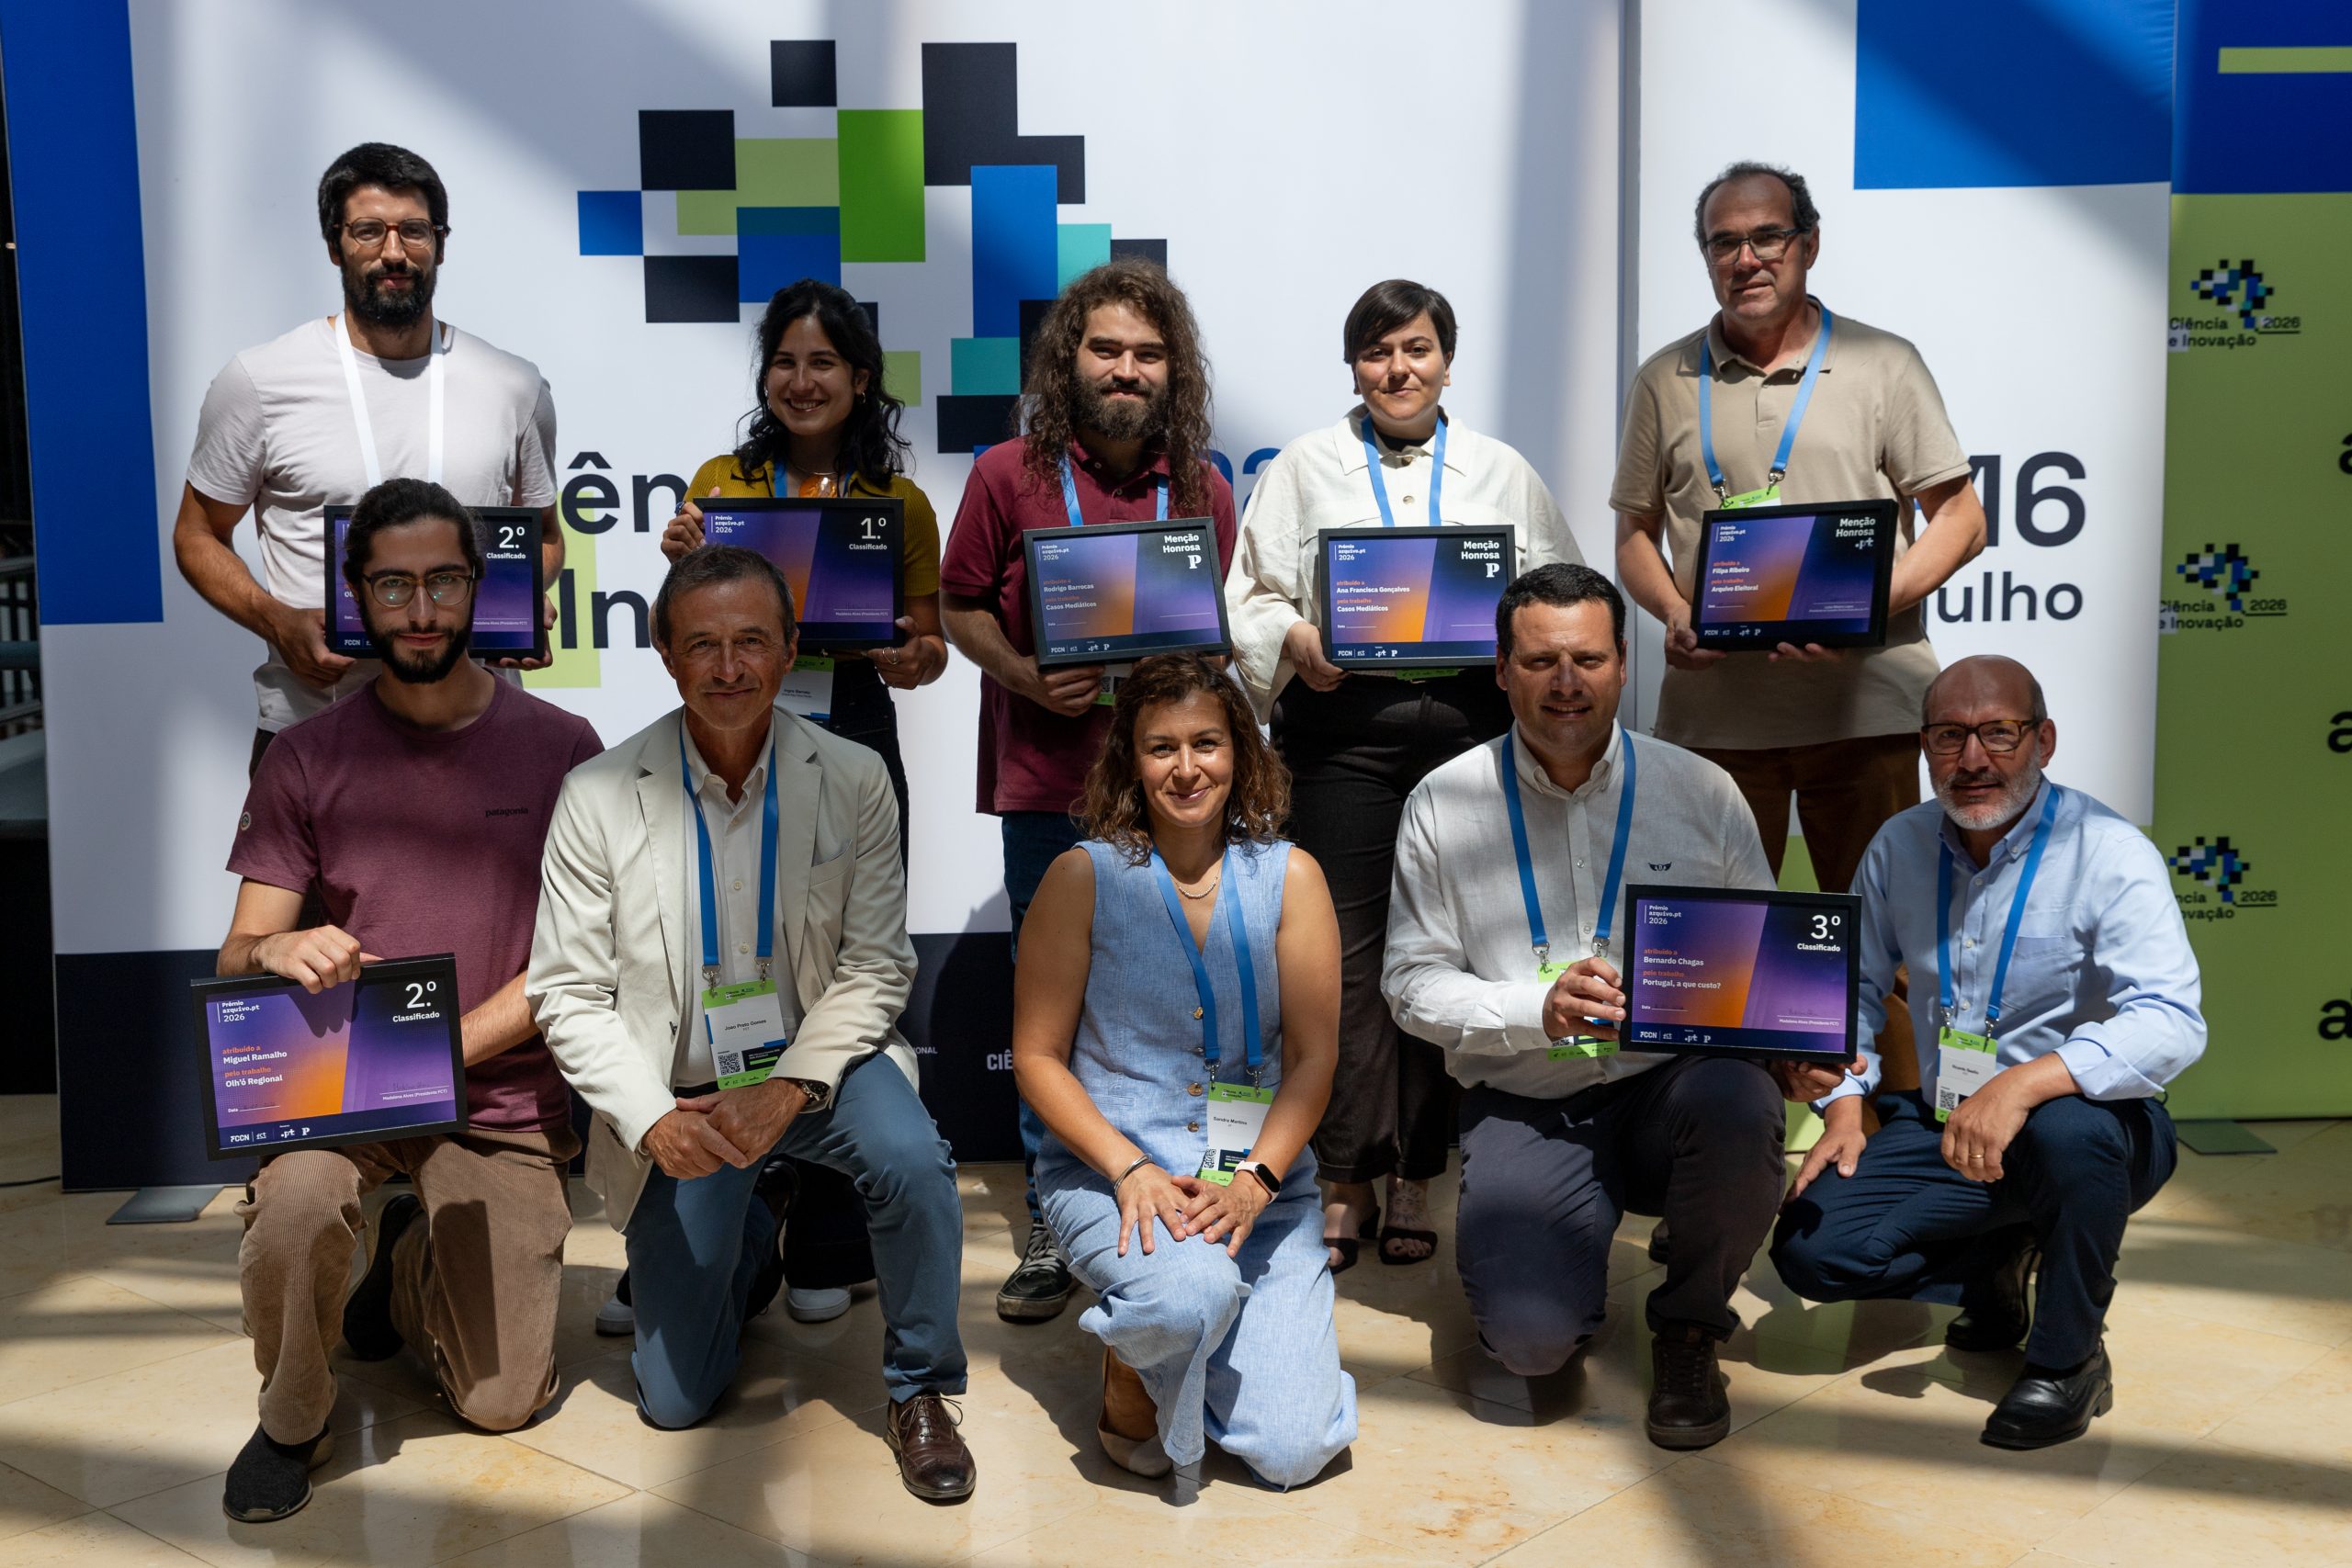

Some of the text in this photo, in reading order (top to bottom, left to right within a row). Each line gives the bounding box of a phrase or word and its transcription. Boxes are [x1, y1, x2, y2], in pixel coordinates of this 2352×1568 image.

[2168, 317, 2301, 331] Ciência 2026
[2168, 333, 2256, 349] e Inovação
[1839, 517, 1876, 528] Menção
[1164, 533, 1200, 544] Menção
[1836, 528, 1874, 538] Honrosa
[1162, 543, 1201, 554] Honrosa
[1464, 540, 1499, 552] Menção
[1461, 551, 1500, 560] Honrosa
[1188, 555, 1202, 570] P
[1486, 562, 1500, 578] P
[1044, 583, 1094, 593] Rodrigo Barrocas
[1379, 585, 1410, 594] Gonçalves
[1712, 584, 1758, 593] Arquivo Eleitoral
[1064, 601, 1097, 610] Mediáticos
[1356, 604, 1388, 613] Mediáticos
[2250, 599, 2288, 611] 2026
[2171, 615, 2244, 631] Inovação
[485, 807, 529, 818] patagonia
[2176, 890, 2278, 904] ncia 2026
[1797, 942, 1841, 953] Classificado
[1644, 956, 1704, 967] Bernardo Chagas
[1643, 978, 1676, 988] Portugal,
[1698, 981, 1721, 989] custo?
[222, 1003, 260, 1014] arquivo.pt
[223, 1013, 245, 1022] 2026
[392, 1010, 440, 1023] Classificado
[1640, 1031, 1657, 1039] FCCN
[1703, 1035, 1712, 1043] P
[222, 1044, 254, 1055] atribuído
[223, 1050, 288, 1065] Miguel Ramalho
[224, 1066, 271, 1078] pelo trabalho
[247, 1074, 283, 1086] Regional
[230, 1134, 250, 1143] FCCN
[301, 1127, 311, 1136] P
